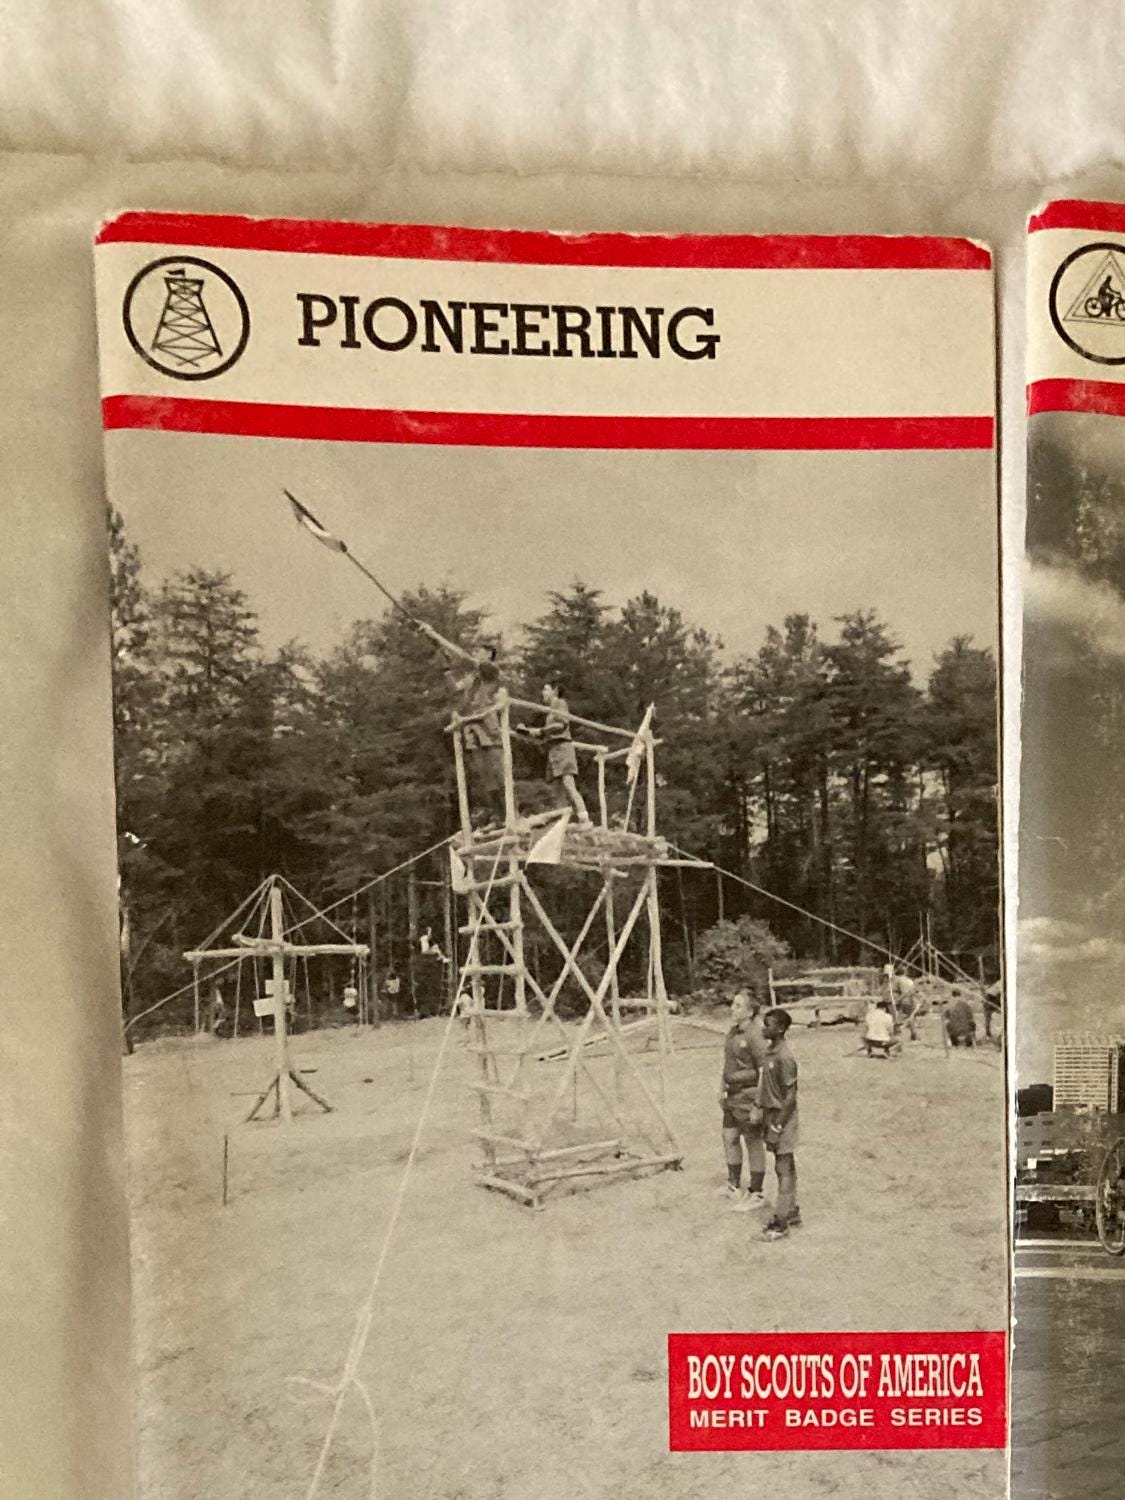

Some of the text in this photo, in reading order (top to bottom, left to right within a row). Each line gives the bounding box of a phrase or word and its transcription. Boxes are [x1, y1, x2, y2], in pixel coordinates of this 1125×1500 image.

[296, 291, 721, 362] PIONEERING
[688, 1353, 984, 1399] BOY SCOUTS OF AMERICA
[690, 1407, 983, 1428] MERIT BADGE SERIES
